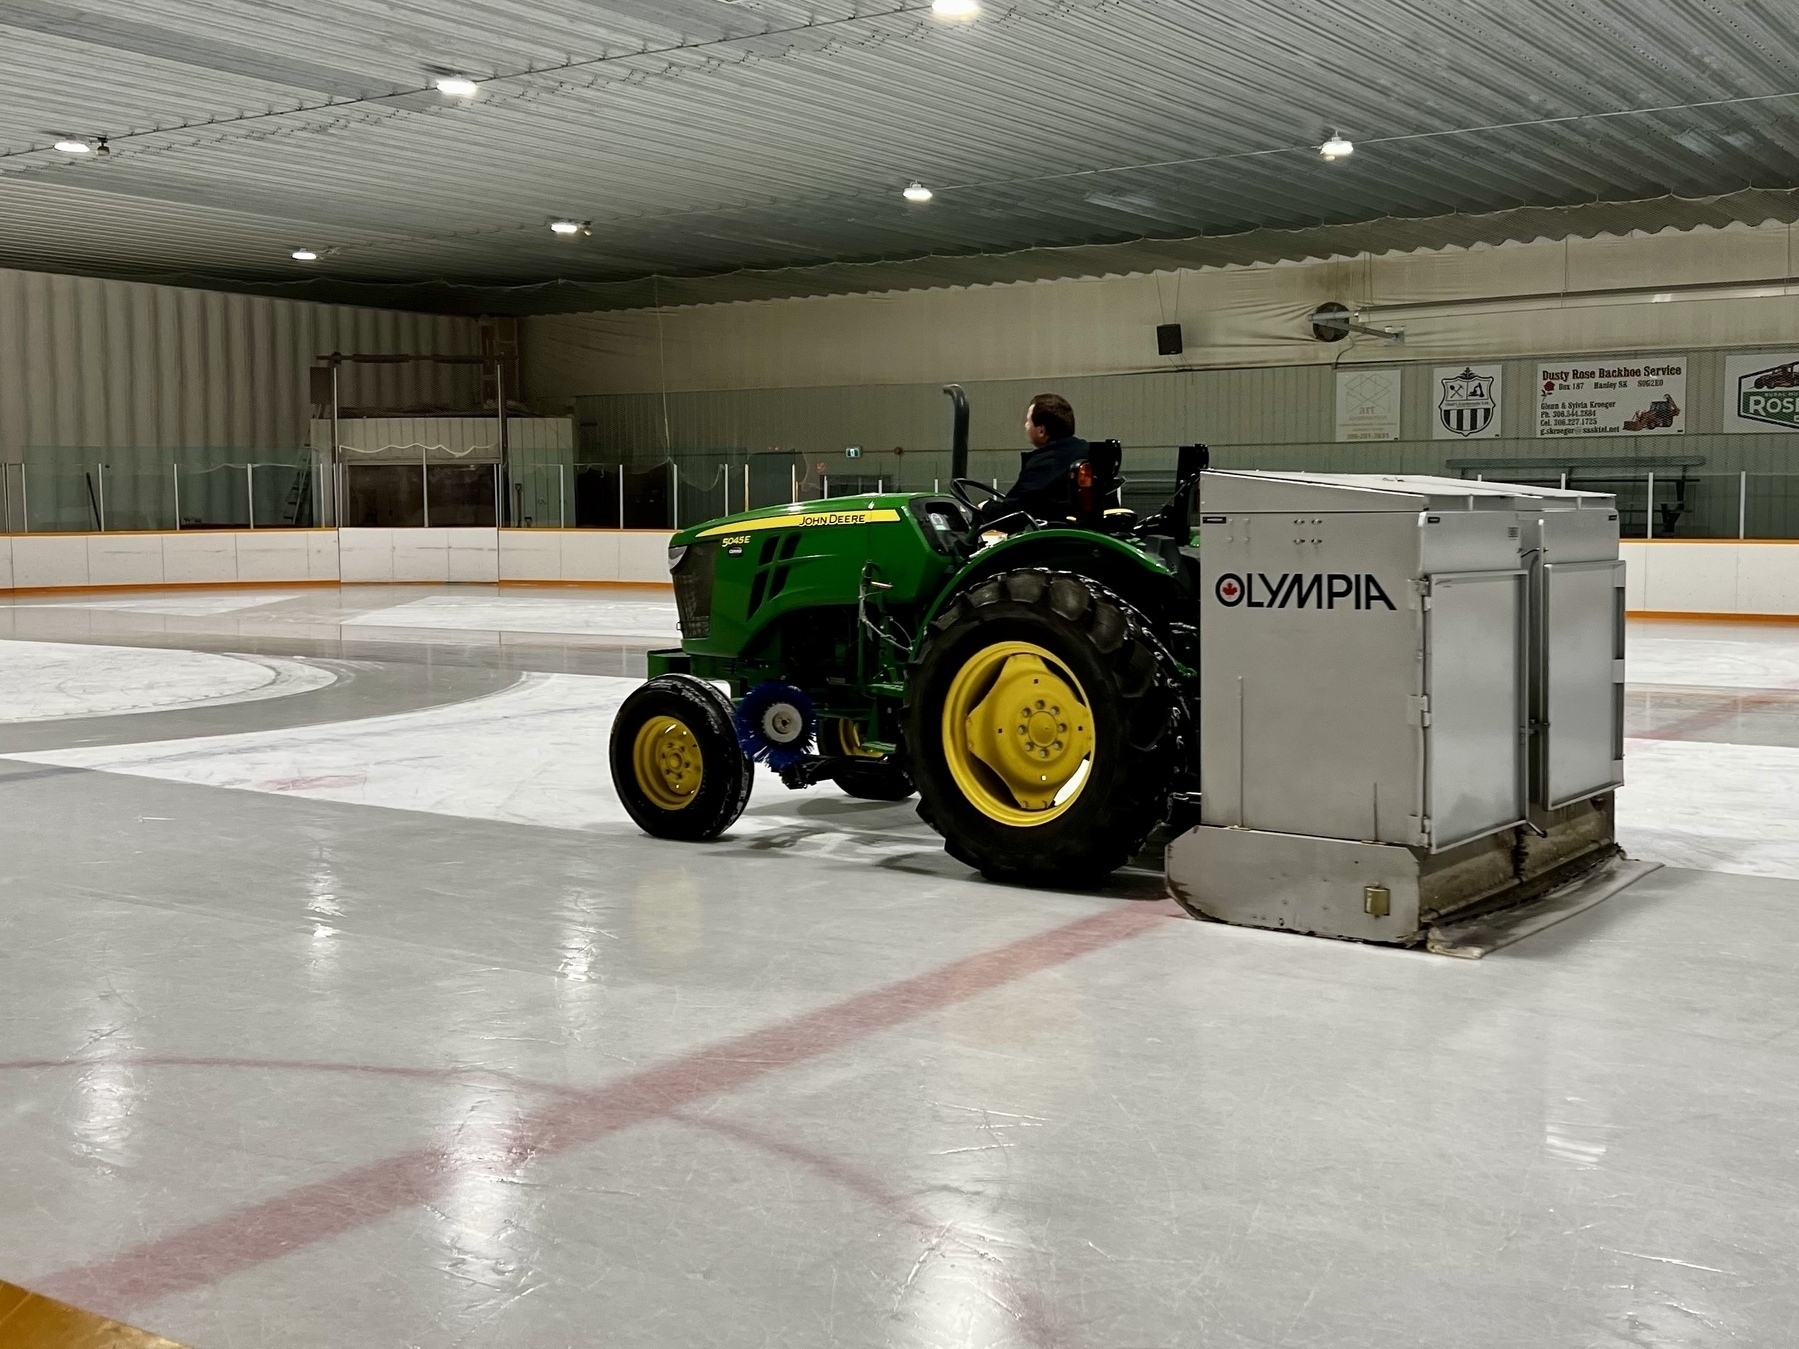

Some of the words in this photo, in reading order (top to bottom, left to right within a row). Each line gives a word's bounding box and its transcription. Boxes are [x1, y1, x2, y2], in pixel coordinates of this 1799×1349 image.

[1542, 371, 1569, 382] Dusty
[1572, 369, 1596, 379] Rose
[1598, 367, 1641, 378] Backhoe
[1644, 365, 1682, 376] Service
[799, 515, 828, 527] JOHN
[829, 513, 866, 525] DEERE
[721, 535, 752, 548] 5045E
[1215, 572, 1398, 611] OLYMPIA
